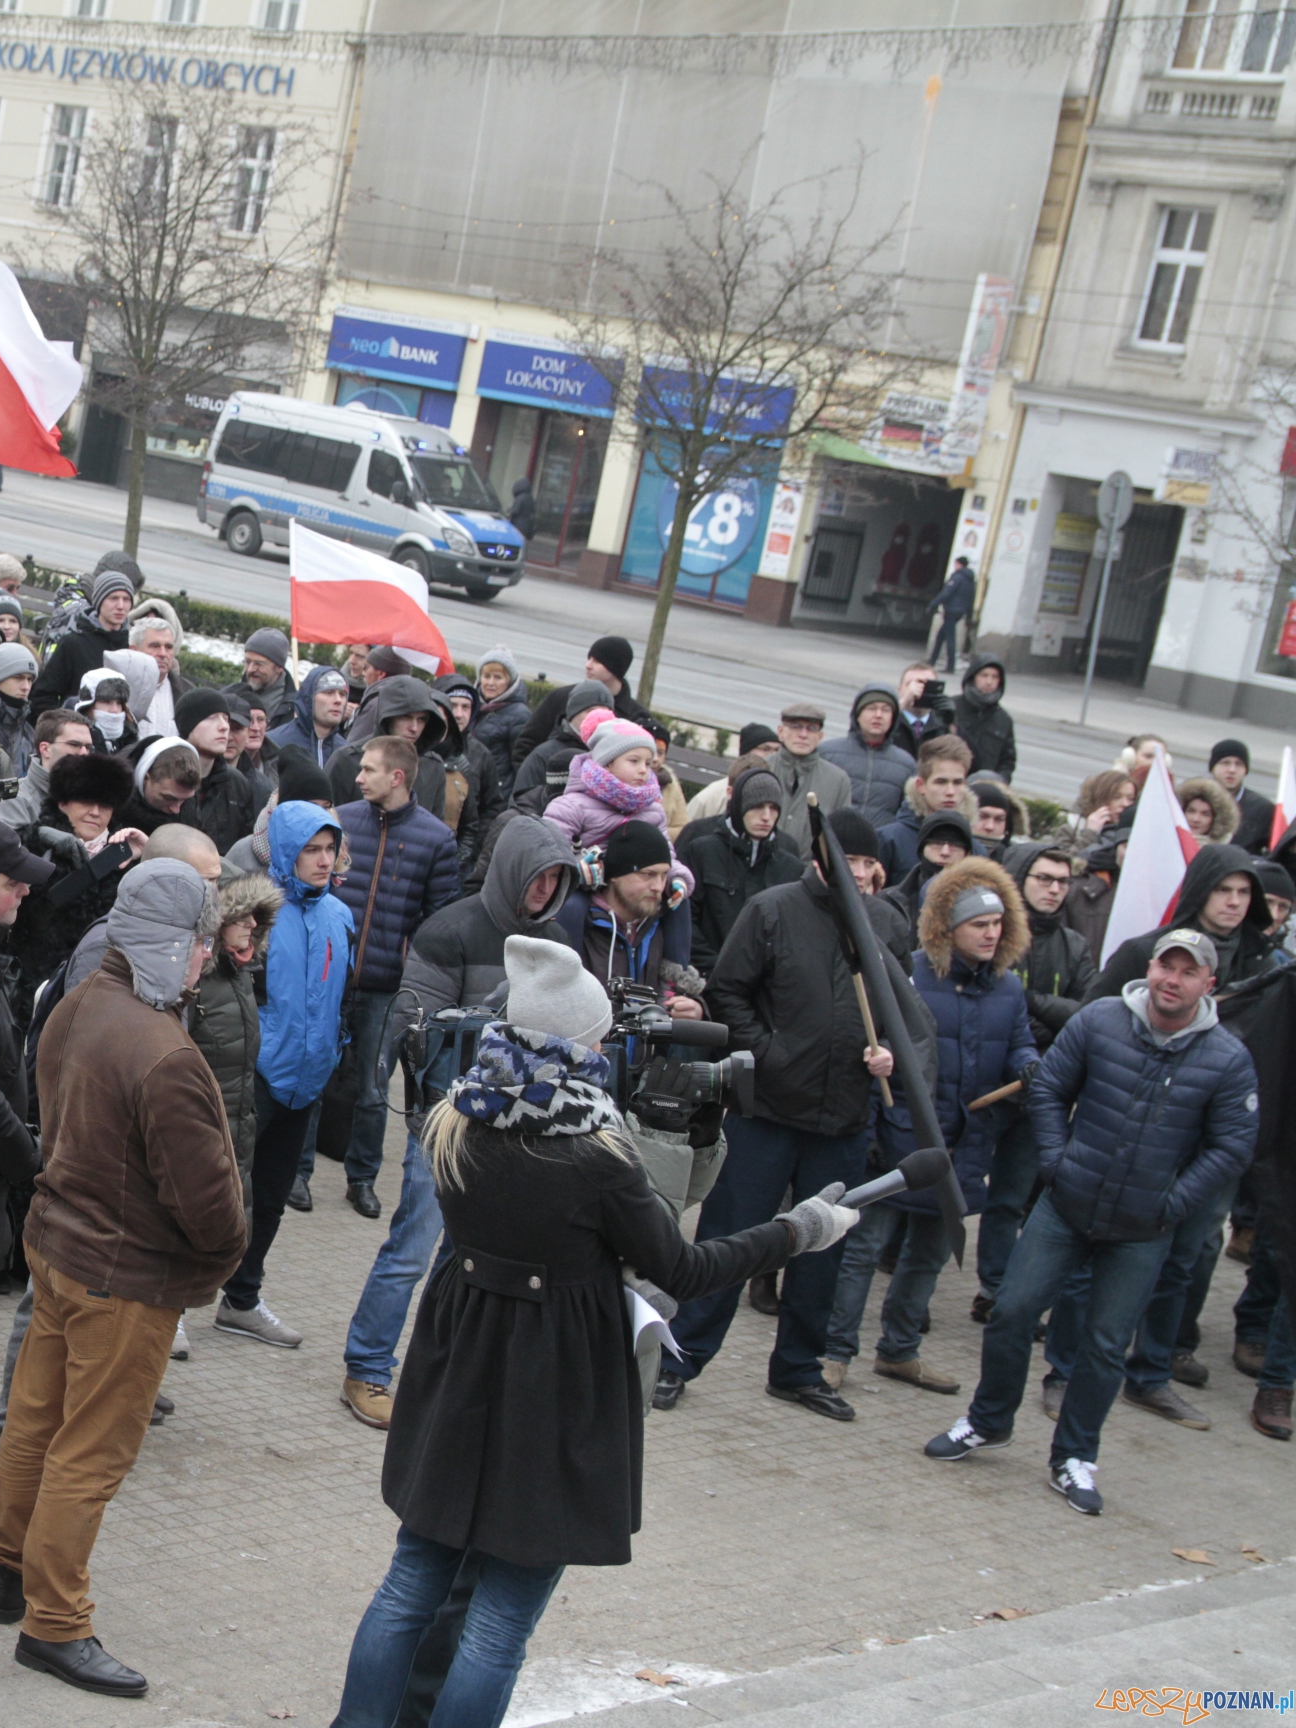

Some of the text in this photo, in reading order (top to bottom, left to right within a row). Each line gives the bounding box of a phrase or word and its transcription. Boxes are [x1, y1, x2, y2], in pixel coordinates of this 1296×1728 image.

[57, 46, 178, 86] JĘZYKÓW
[180, 57, 295, 98] OBCYCH
[400, 344, 440, 366] BANK
[531, 355, 566, 375] DOM
[505, 368, 586, 398] LOKACYJNY
[185, 393, 226, 413] HUBLO
[651, 1100, 679, 1108] FUJINON
